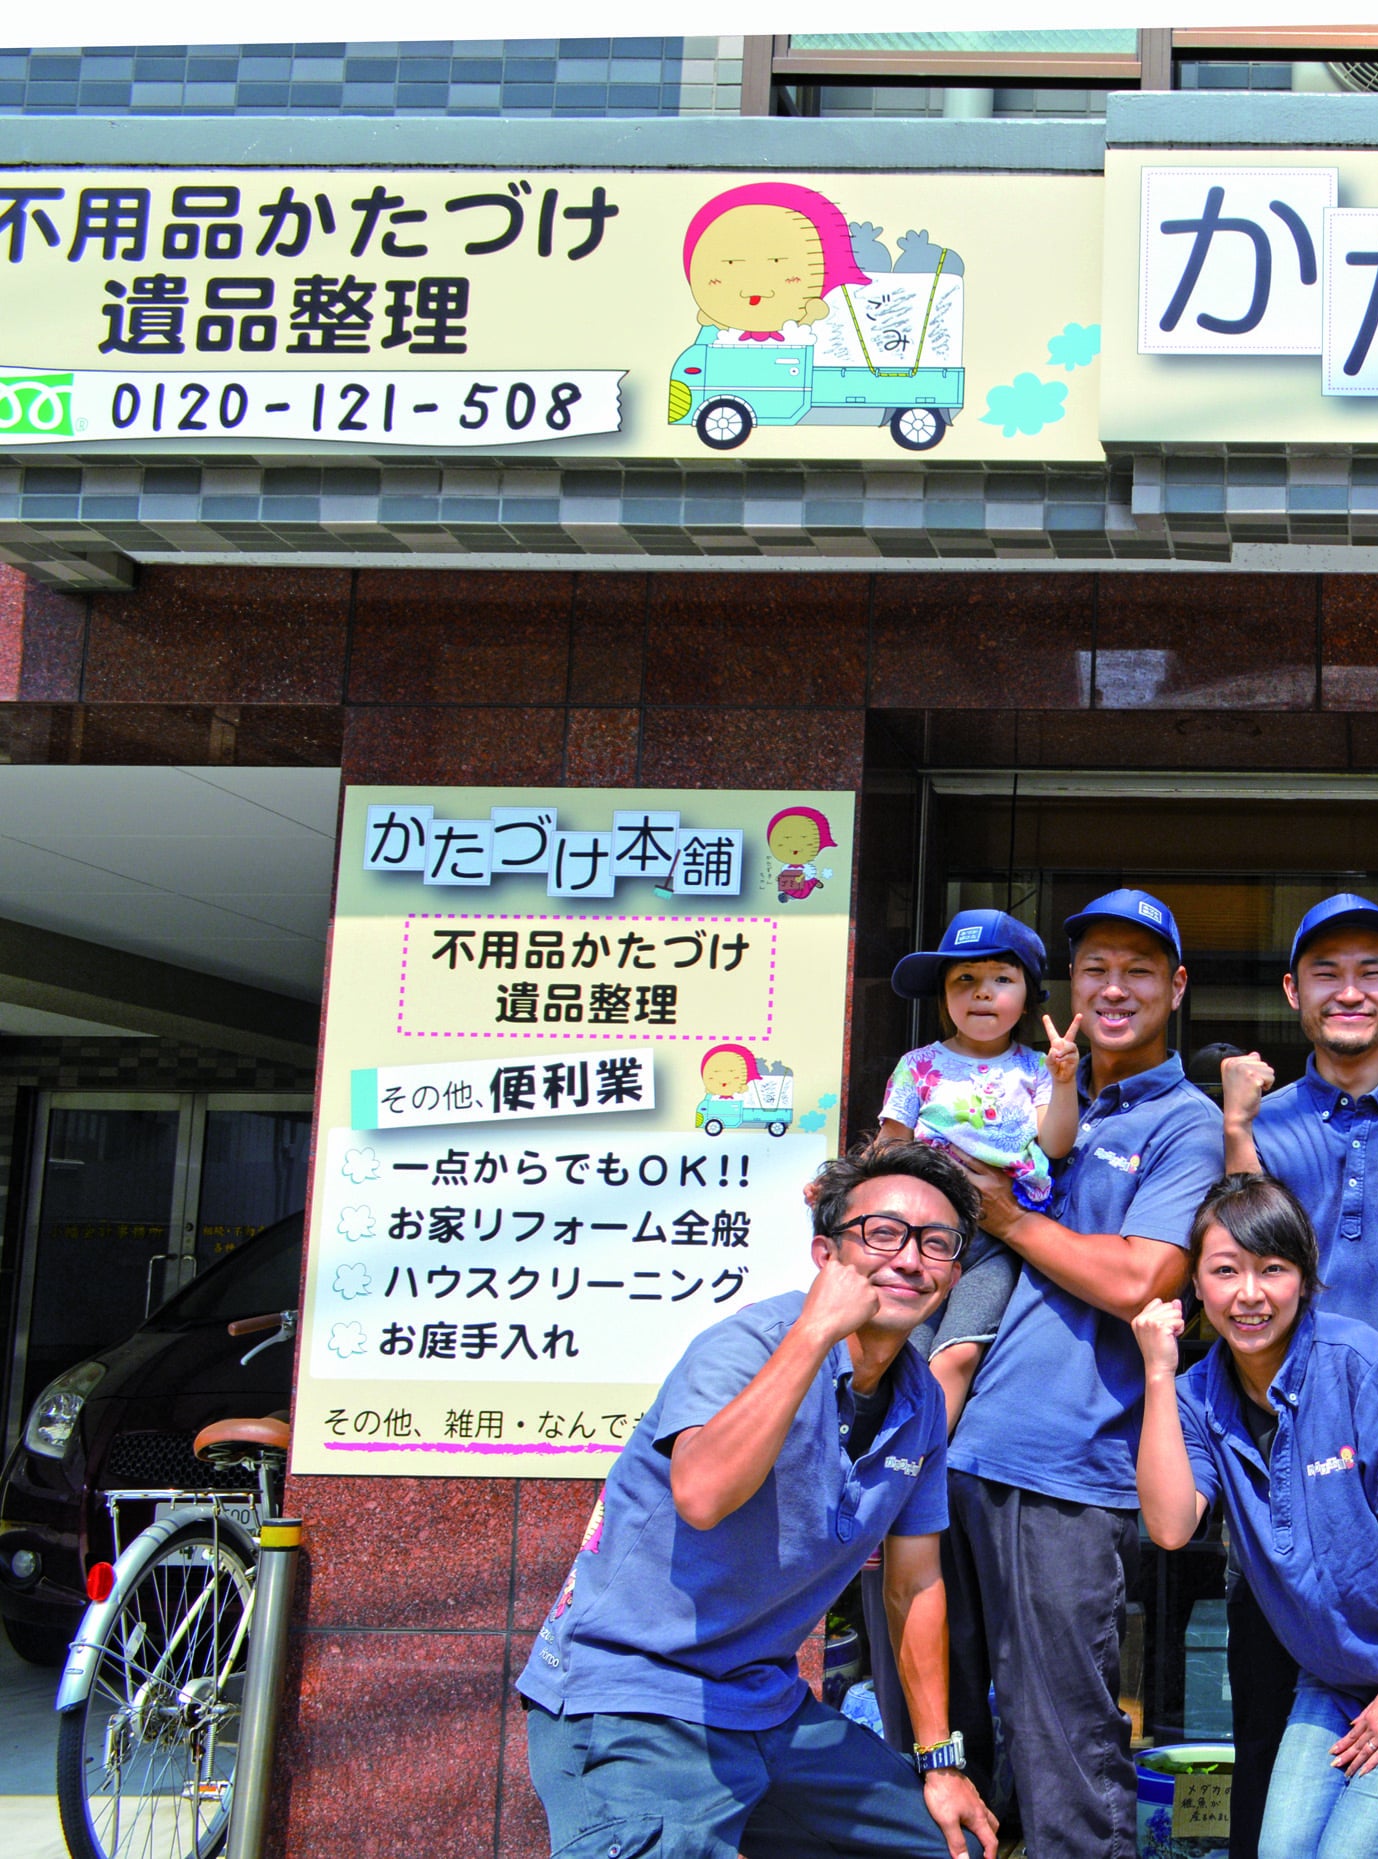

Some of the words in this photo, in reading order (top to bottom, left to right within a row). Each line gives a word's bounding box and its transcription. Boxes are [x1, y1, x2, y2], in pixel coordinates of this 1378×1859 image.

[0, 180, 620, 263] 不用品かたづけ
[97, 273, 471, 355] 遺品整理
[111, 381, 582, 433] 0120-121-508
[370, 811, 735, 891] かたづけ本舗
[432, 928, 750, 971] 不用品かたづけ
[495, 982, 678, 1025] 遺品整理
[387, 1208, 752, 1249] お家リフォーム全般
[384, 1263, 750, 1304] ハウスクリーニング
[379, 1321, 580, 1361] お庭手入れ
[323, 1407, 645, 1440] その他、雑用・なんで
